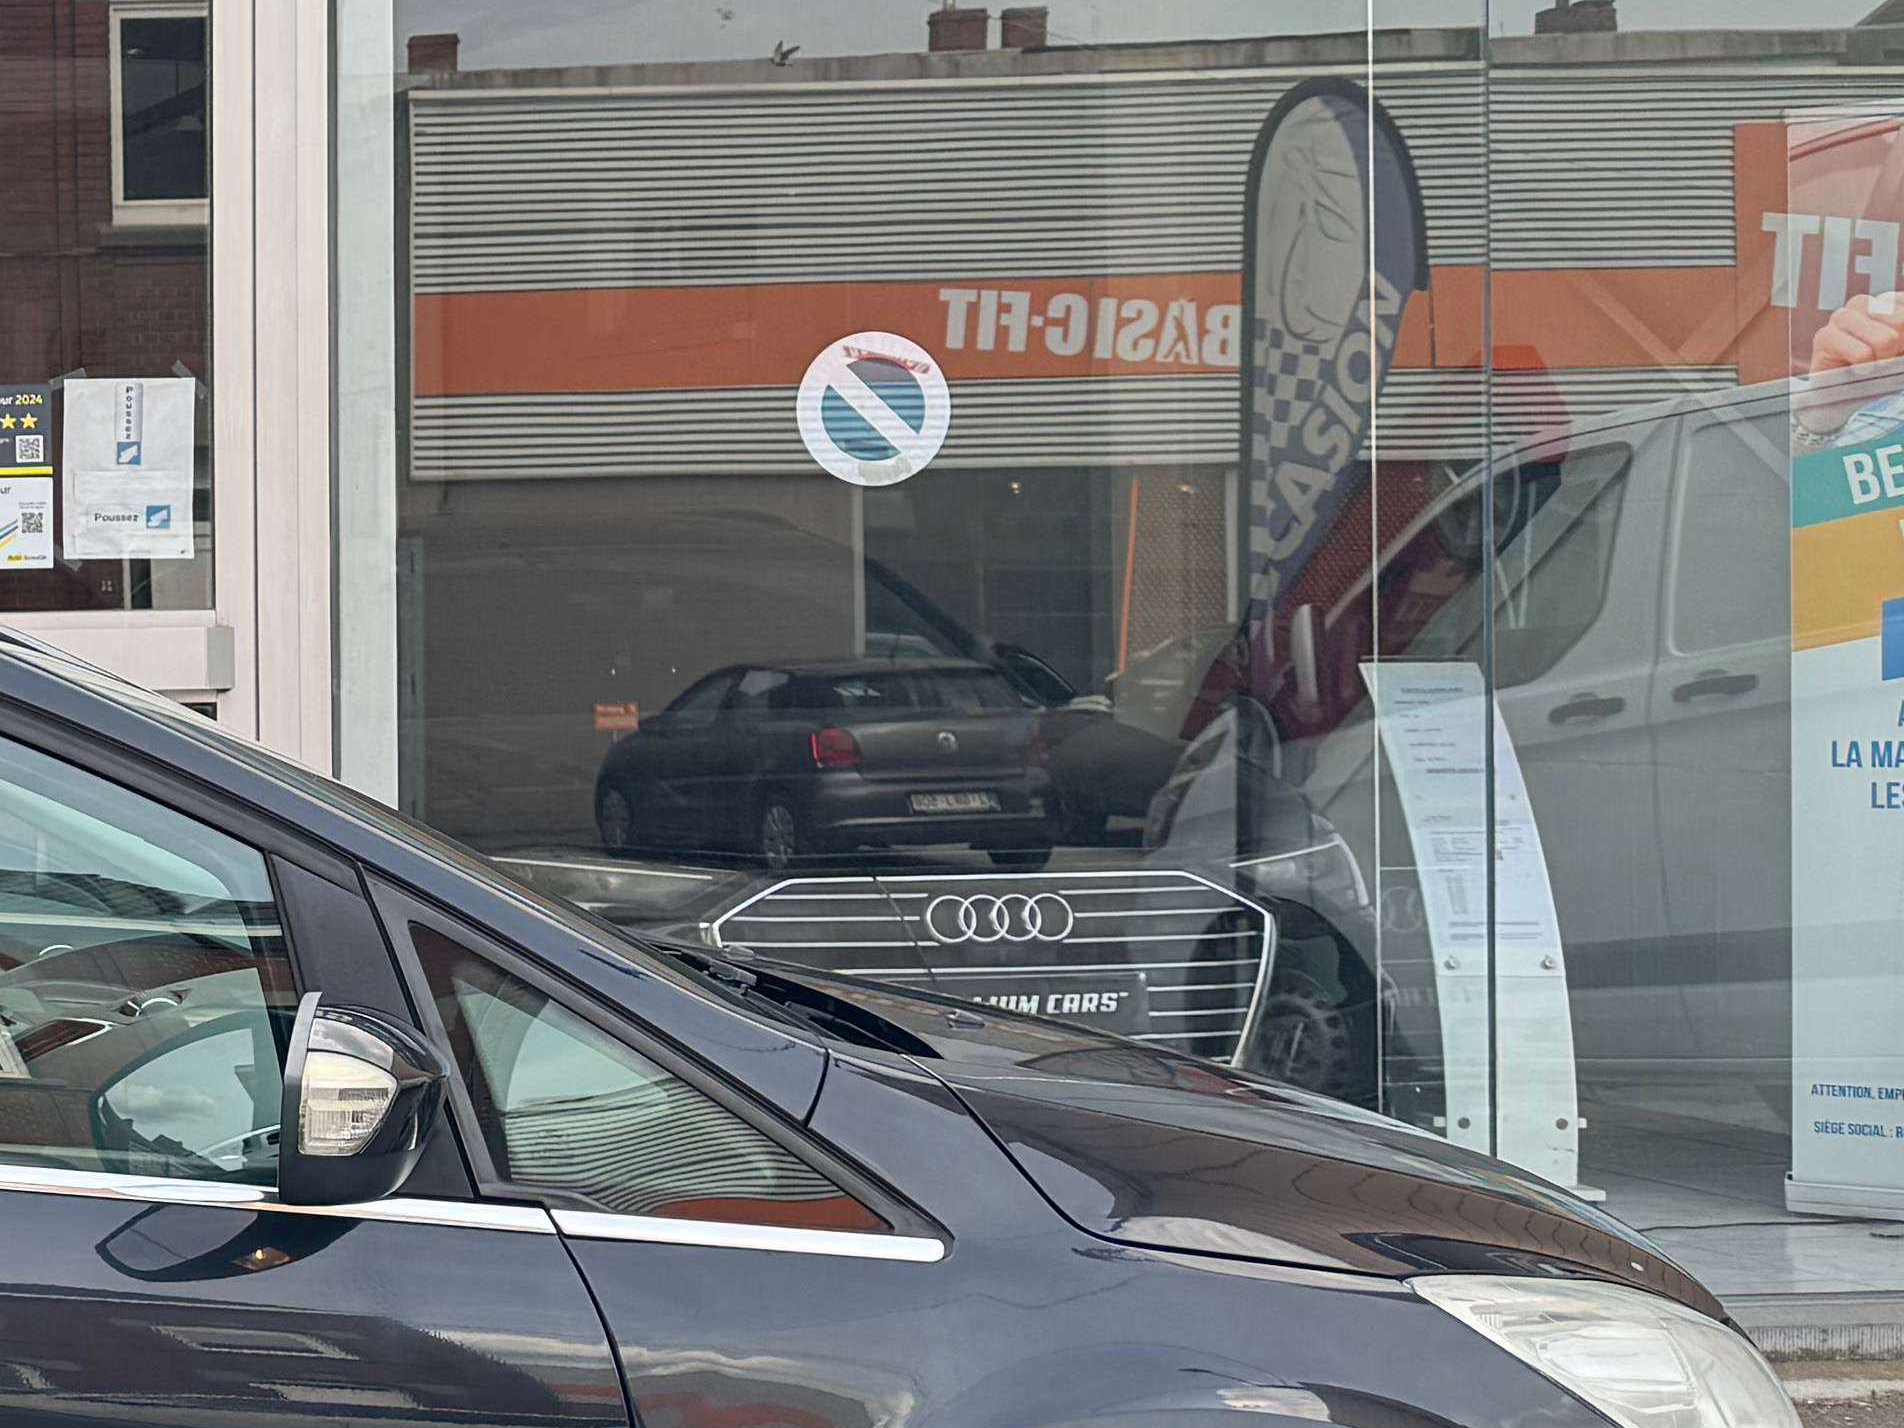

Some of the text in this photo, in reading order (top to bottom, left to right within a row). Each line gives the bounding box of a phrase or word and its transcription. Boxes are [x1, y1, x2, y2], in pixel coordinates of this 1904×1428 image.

[15, 394, 43, 405] 2024
[94, 512, 139, 522] Poussez
[1832, 740, 1863, 768] LA
[1871, 781, 1904, 810] LE
[1046, 992, 1118, 1014] CARS
[1877, 1087, 1904, 1100] EMP
[1814, 1119, 1846, 1135] SIÈGE
[1847, 1123, 1887, 1138] SOCIAL
